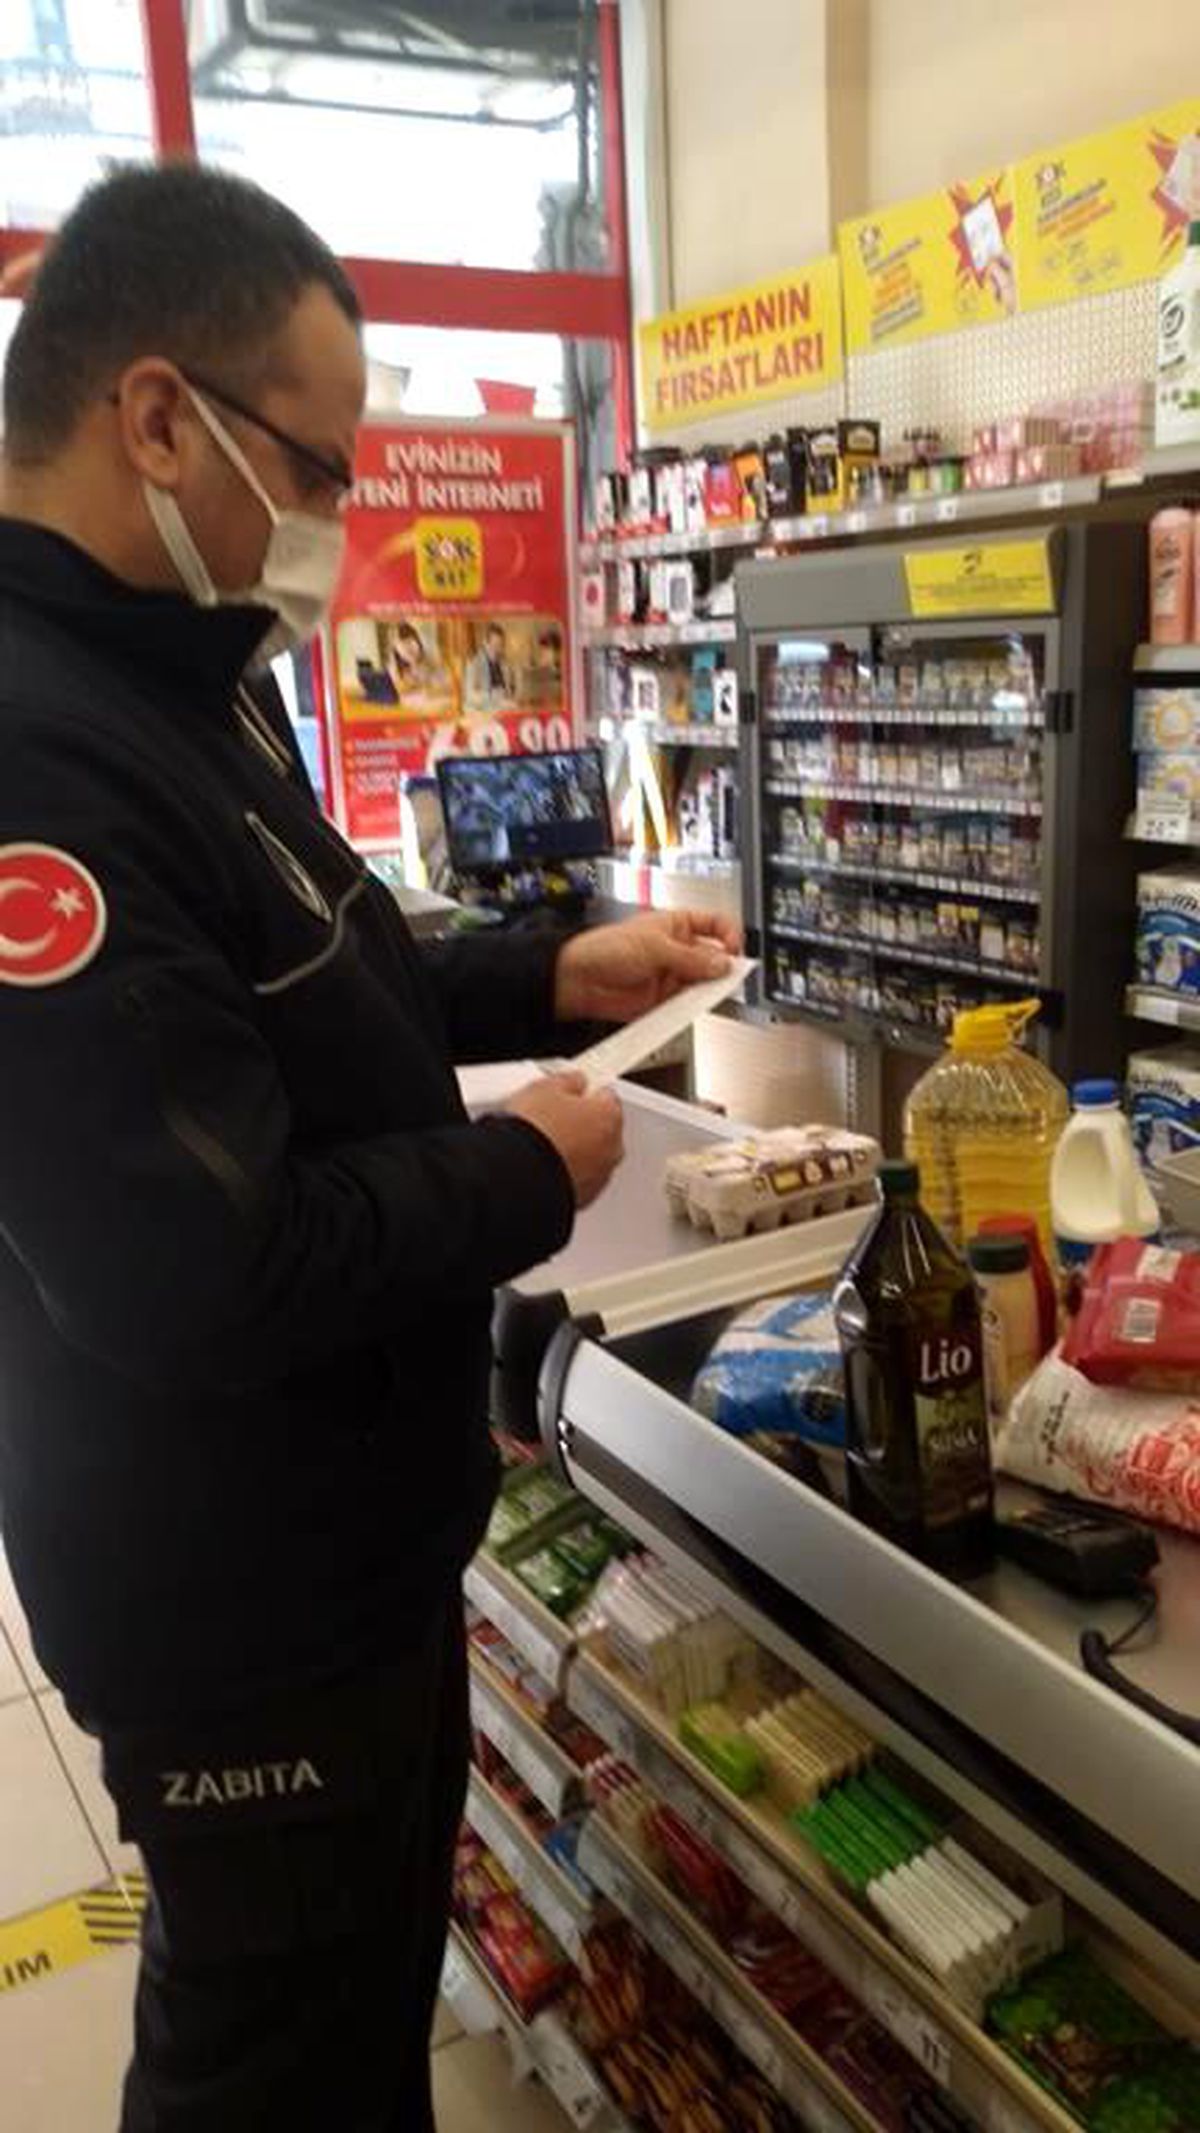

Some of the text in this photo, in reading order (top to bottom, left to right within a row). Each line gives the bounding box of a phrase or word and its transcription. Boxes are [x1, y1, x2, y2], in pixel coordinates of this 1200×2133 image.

[660, 281, 811, 363] HAFTANIN
[656, 332, 823, 414] FIRSATLARI
[920, 1339, 972, 1382] Lio
[162, 1758, 323, 1805] ZABITA
[0, 1951, 52, 1989] IM
